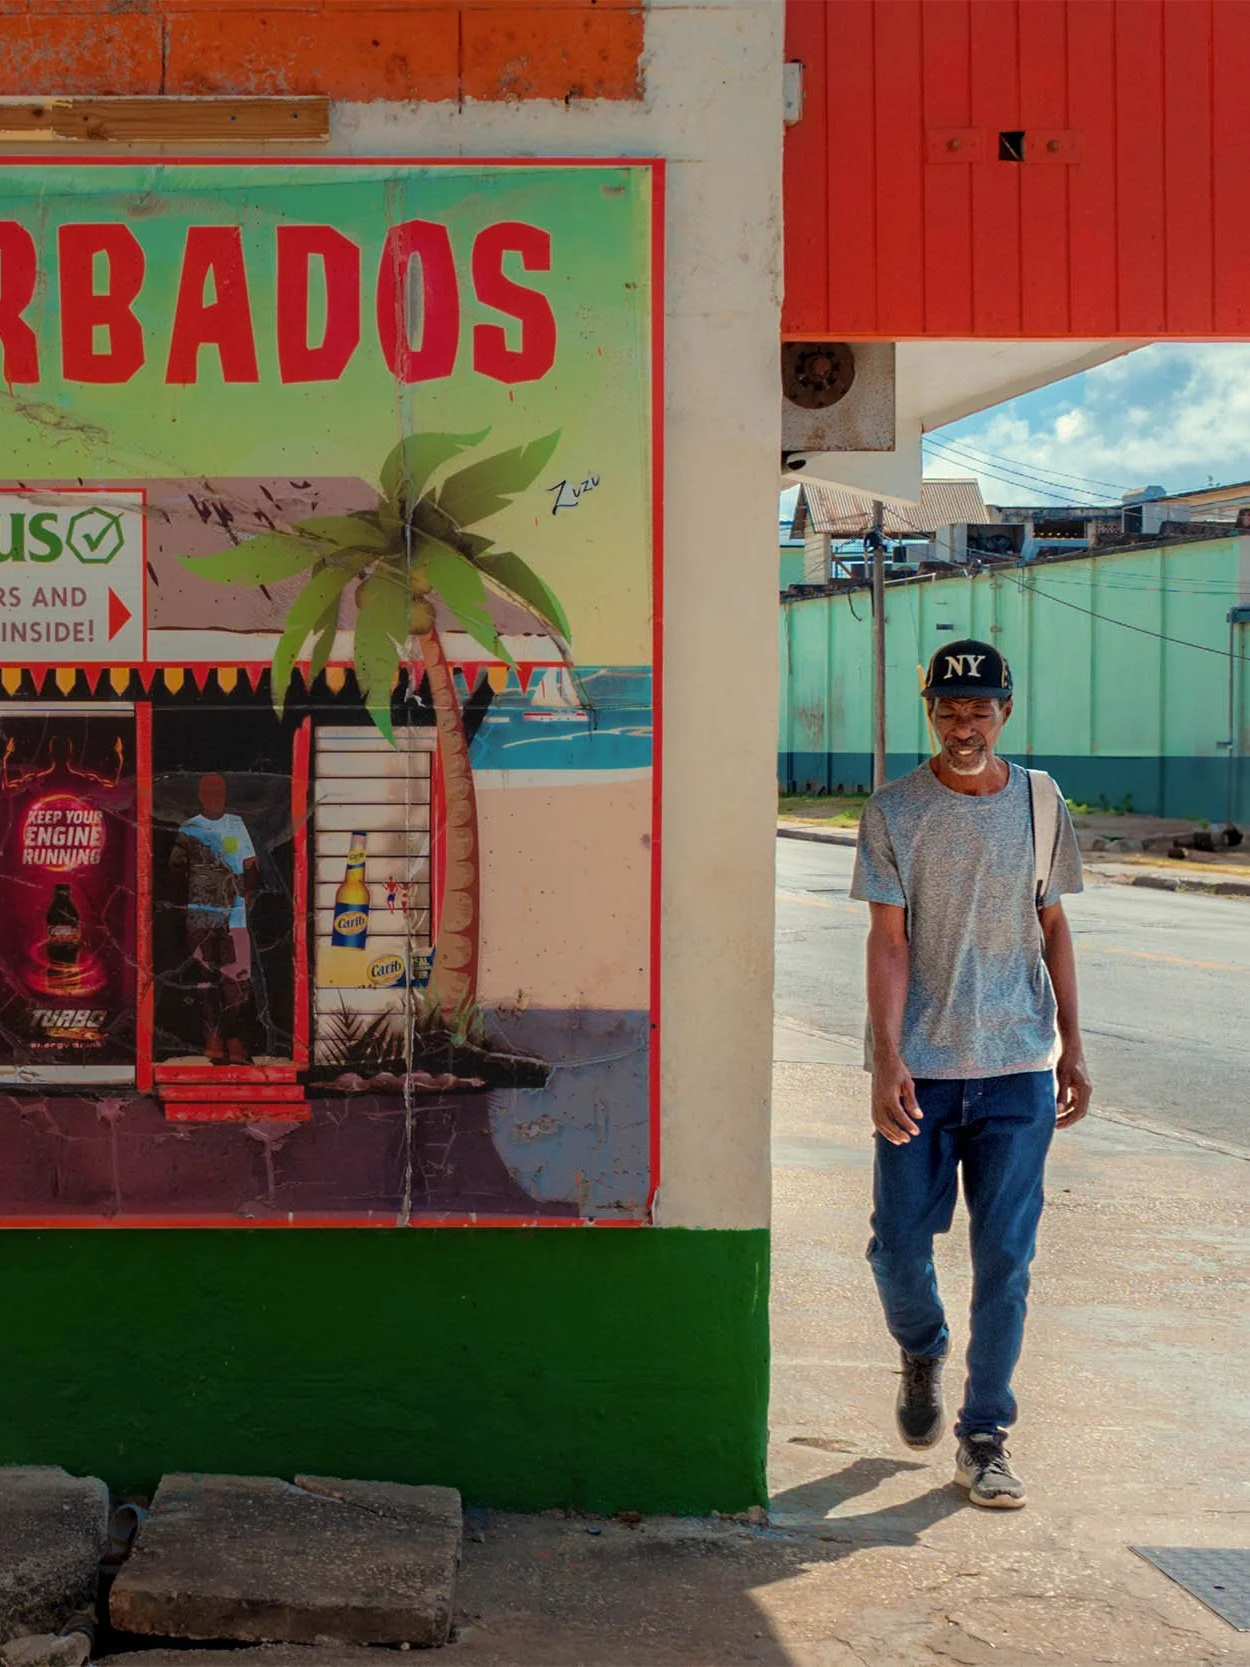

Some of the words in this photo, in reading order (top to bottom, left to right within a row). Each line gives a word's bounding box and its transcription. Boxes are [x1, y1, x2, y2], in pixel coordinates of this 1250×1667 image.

[31, 586, 88, 608] AND
[1, 619, 95, 643] INSIDE!
[943, 654, 987, 680] NY
[28, 810, 64, 825] KEEP
[65, 810, 103, 825] YOUR
[24, 826, 104, 847] ENGINE
[21, 848, 103, 866] RUNNING
[338, 916, 365, 929] Carib
[371, 959, 401, 978] Carib
[30, 1009, 108, 1029] TURBO
